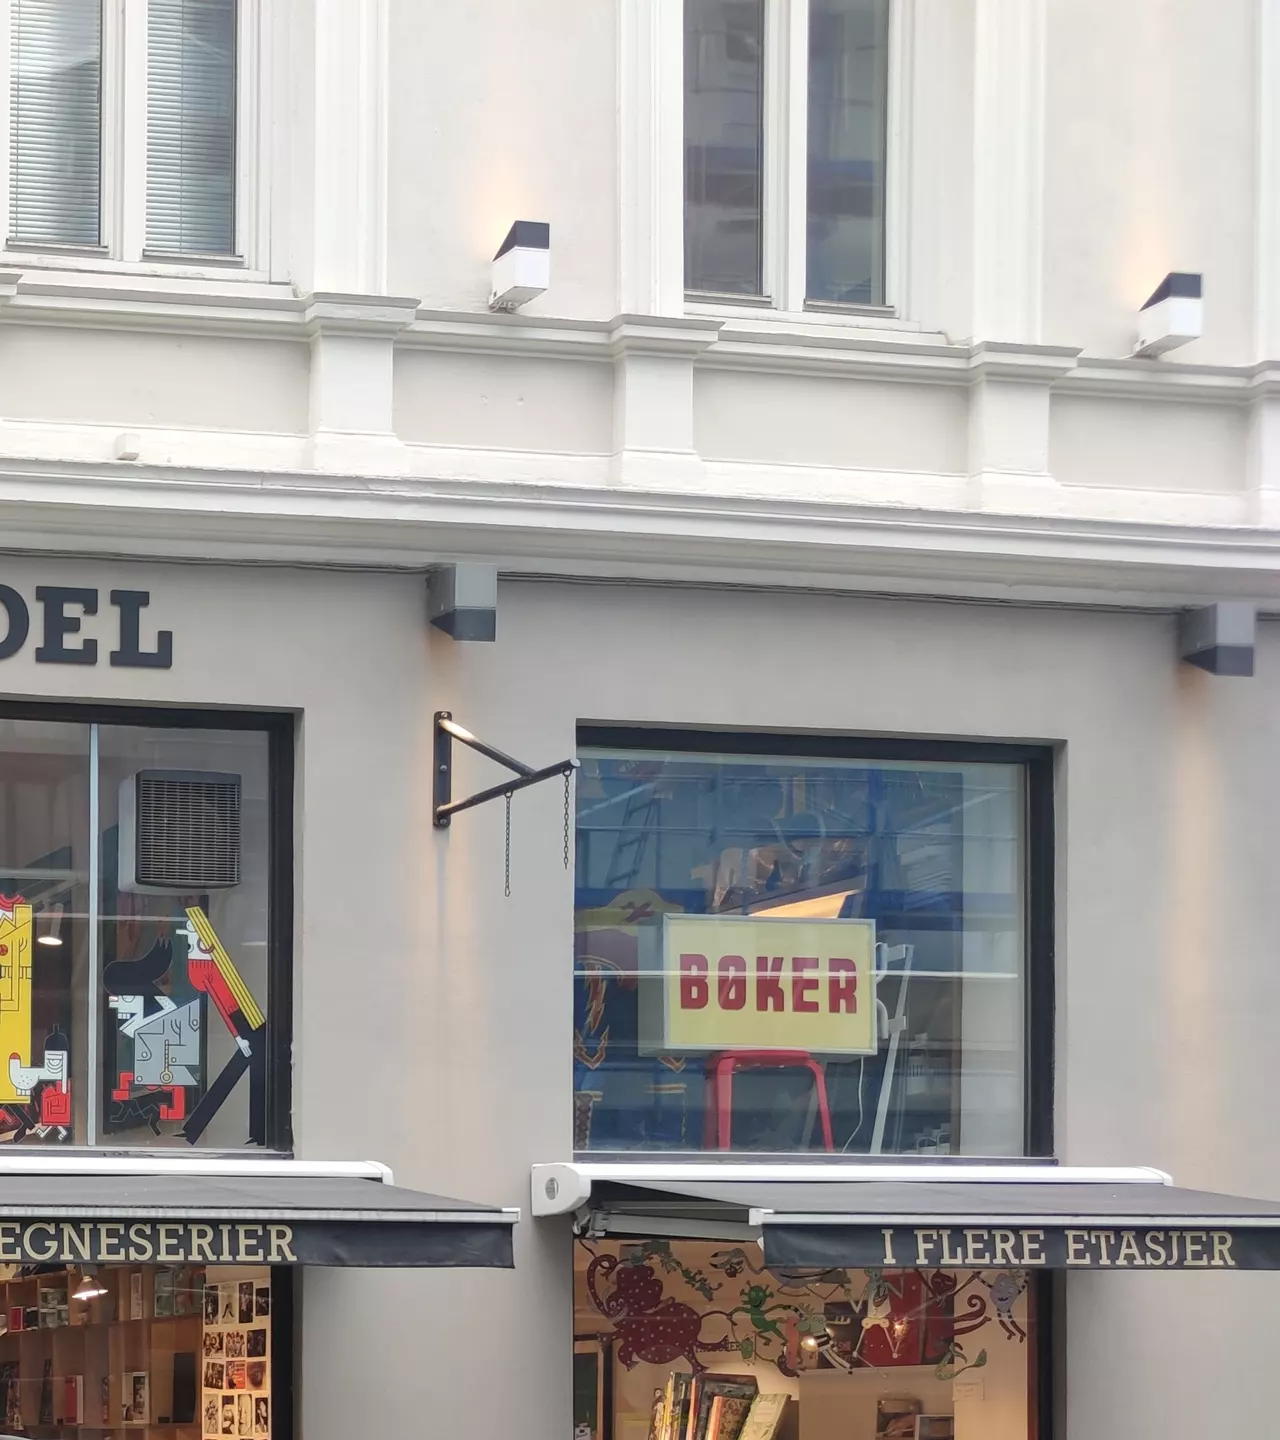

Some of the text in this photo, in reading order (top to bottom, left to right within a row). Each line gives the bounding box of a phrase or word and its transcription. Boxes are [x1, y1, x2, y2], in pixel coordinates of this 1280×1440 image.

[678, 952, 858, 1015] BØKER
[880, 1228, 1236, 1267] I FLERE ETASJER
